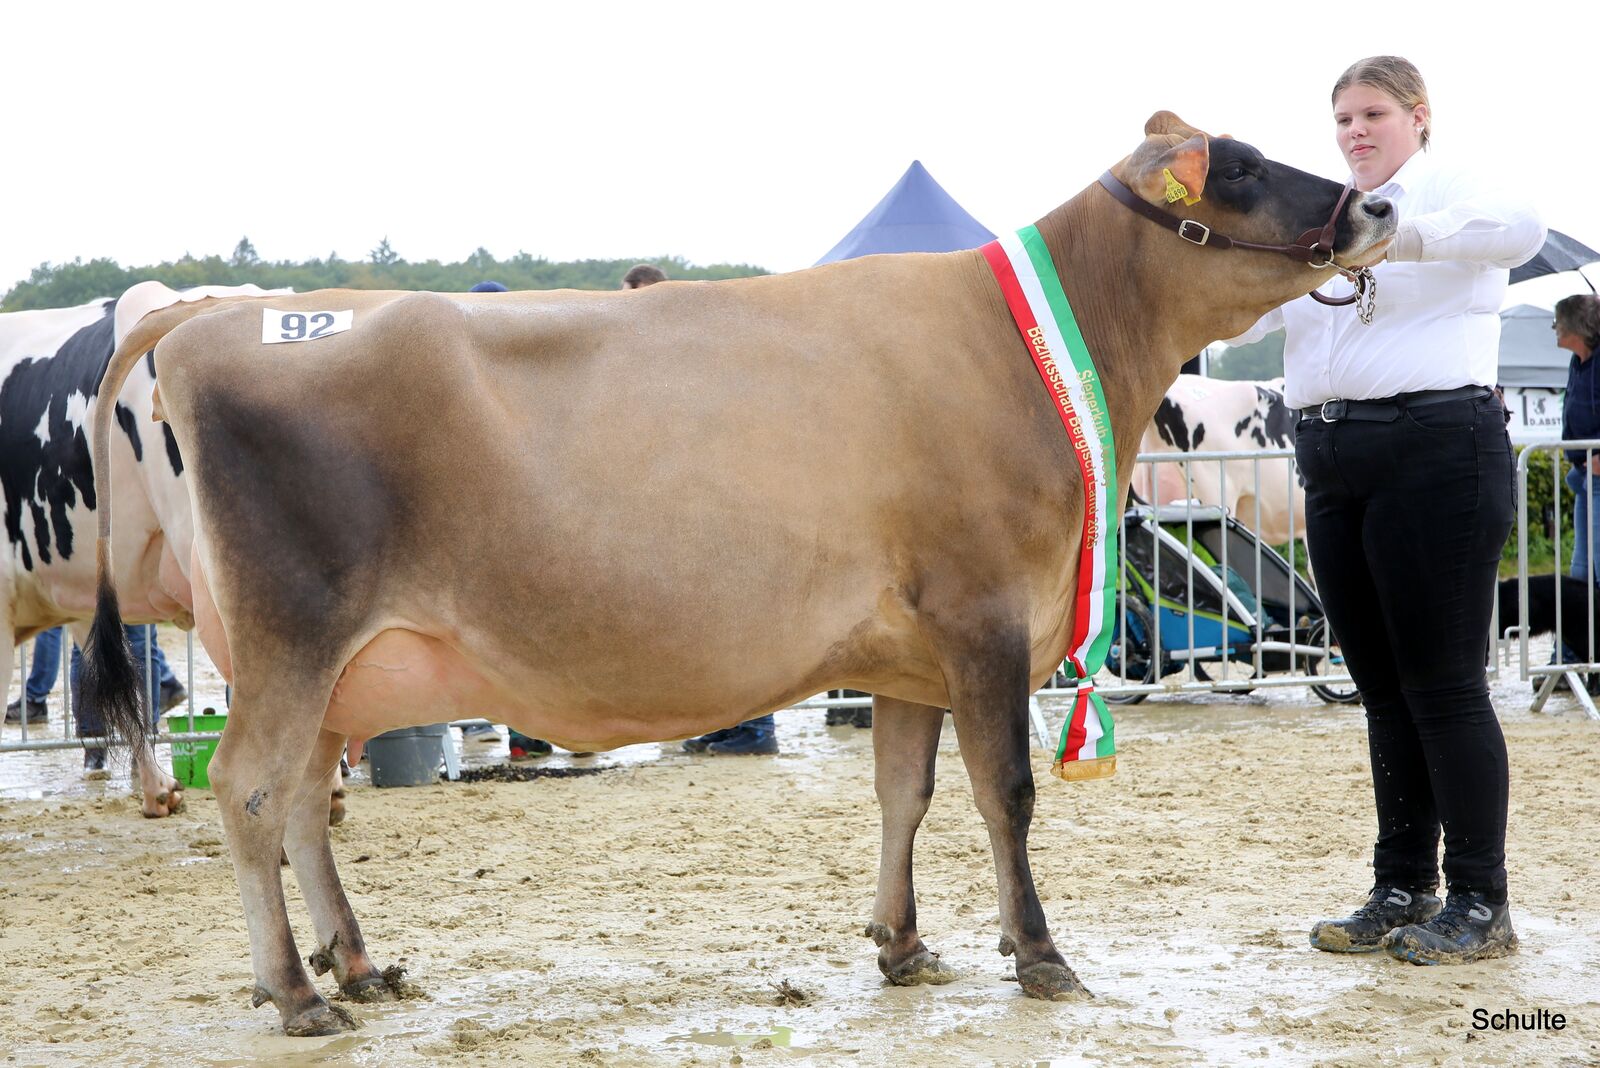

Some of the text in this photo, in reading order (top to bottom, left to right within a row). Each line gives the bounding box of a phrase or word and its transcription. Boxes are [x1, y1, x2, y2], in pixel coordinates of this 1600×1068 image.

[281, 313, 335, 340] 92
[1027, 325, 1074, 415] Bezirksschau
[1068, 416, 1097, 478] Bergisch
[1088, 480, 1099, 515] Land
[1077, 369, 1109, 439] Siegerkuh
